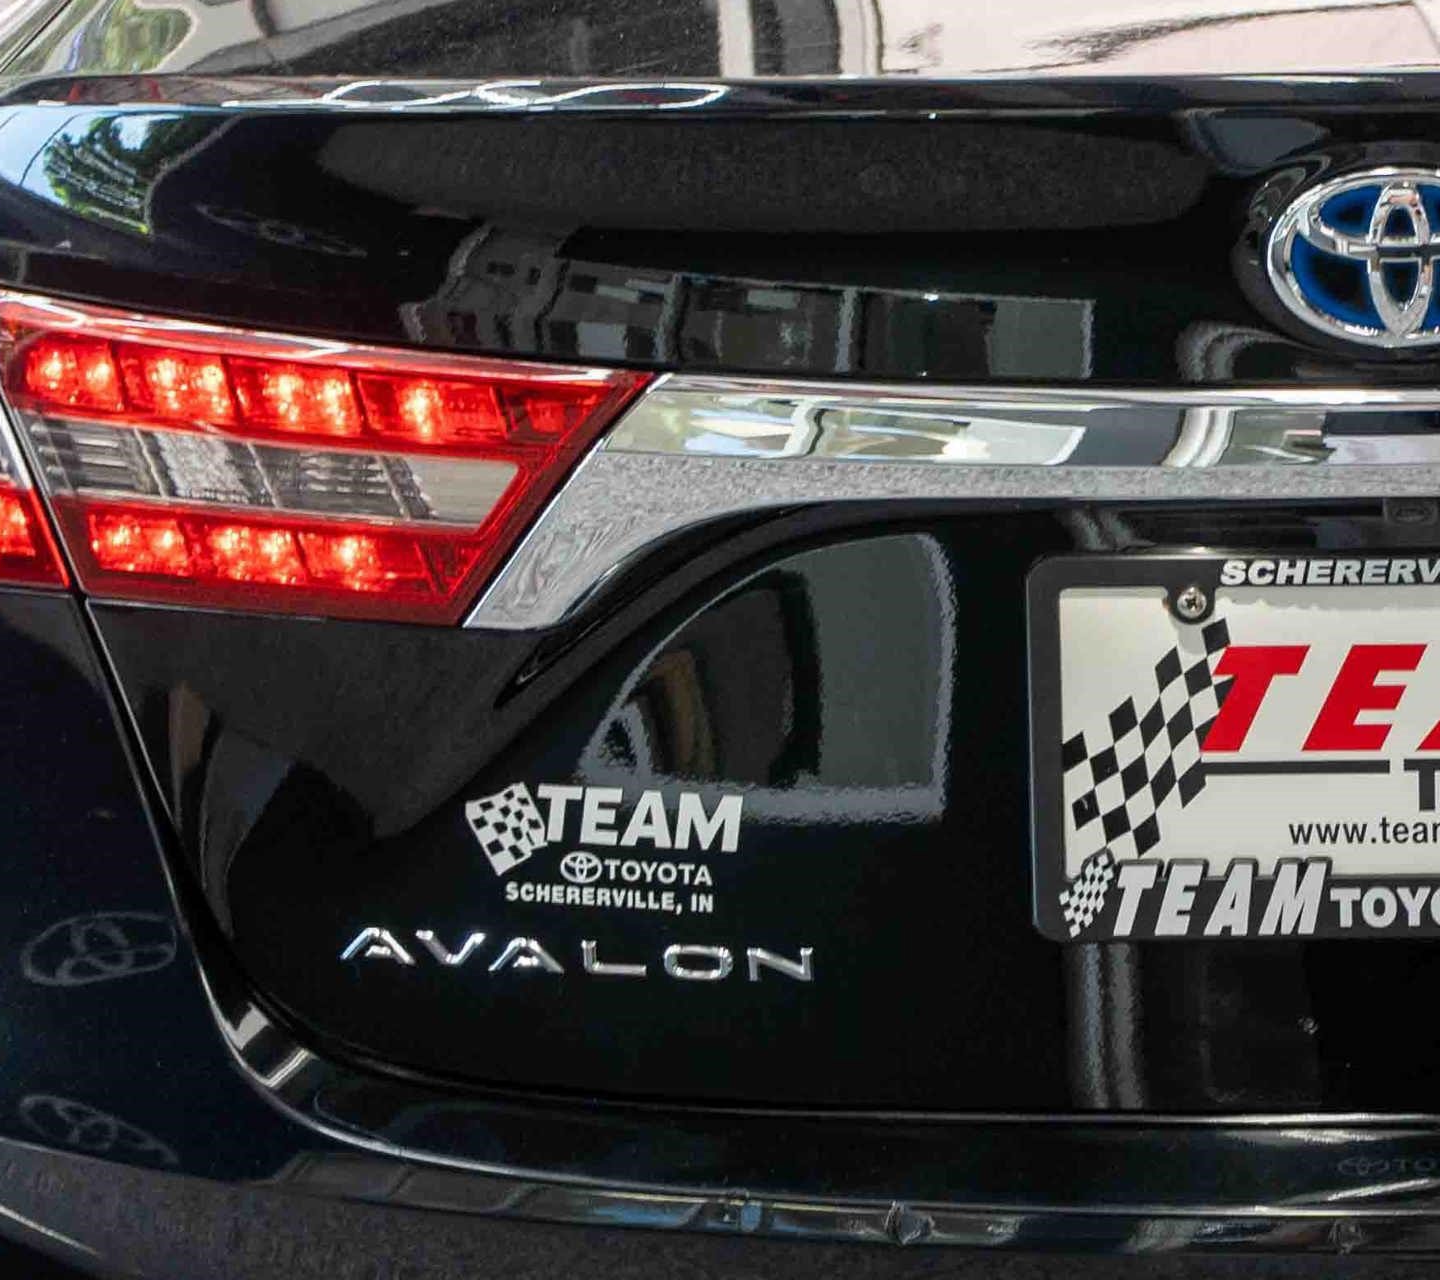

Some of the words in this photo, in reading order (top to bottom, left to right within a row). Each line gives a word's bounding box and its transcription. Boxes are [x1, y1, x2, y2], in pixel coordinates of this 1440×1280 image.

[537, 783, 744, 853] TEAM
[504, 881, 682, 915] SCHERERVILLE,
[690, 893, 714, 914] IN
[604, 859, 713, 886] TOYOTA
[1112, 860, 1333, 937] TEAM
[340, 926, 815, 982] AVALON
